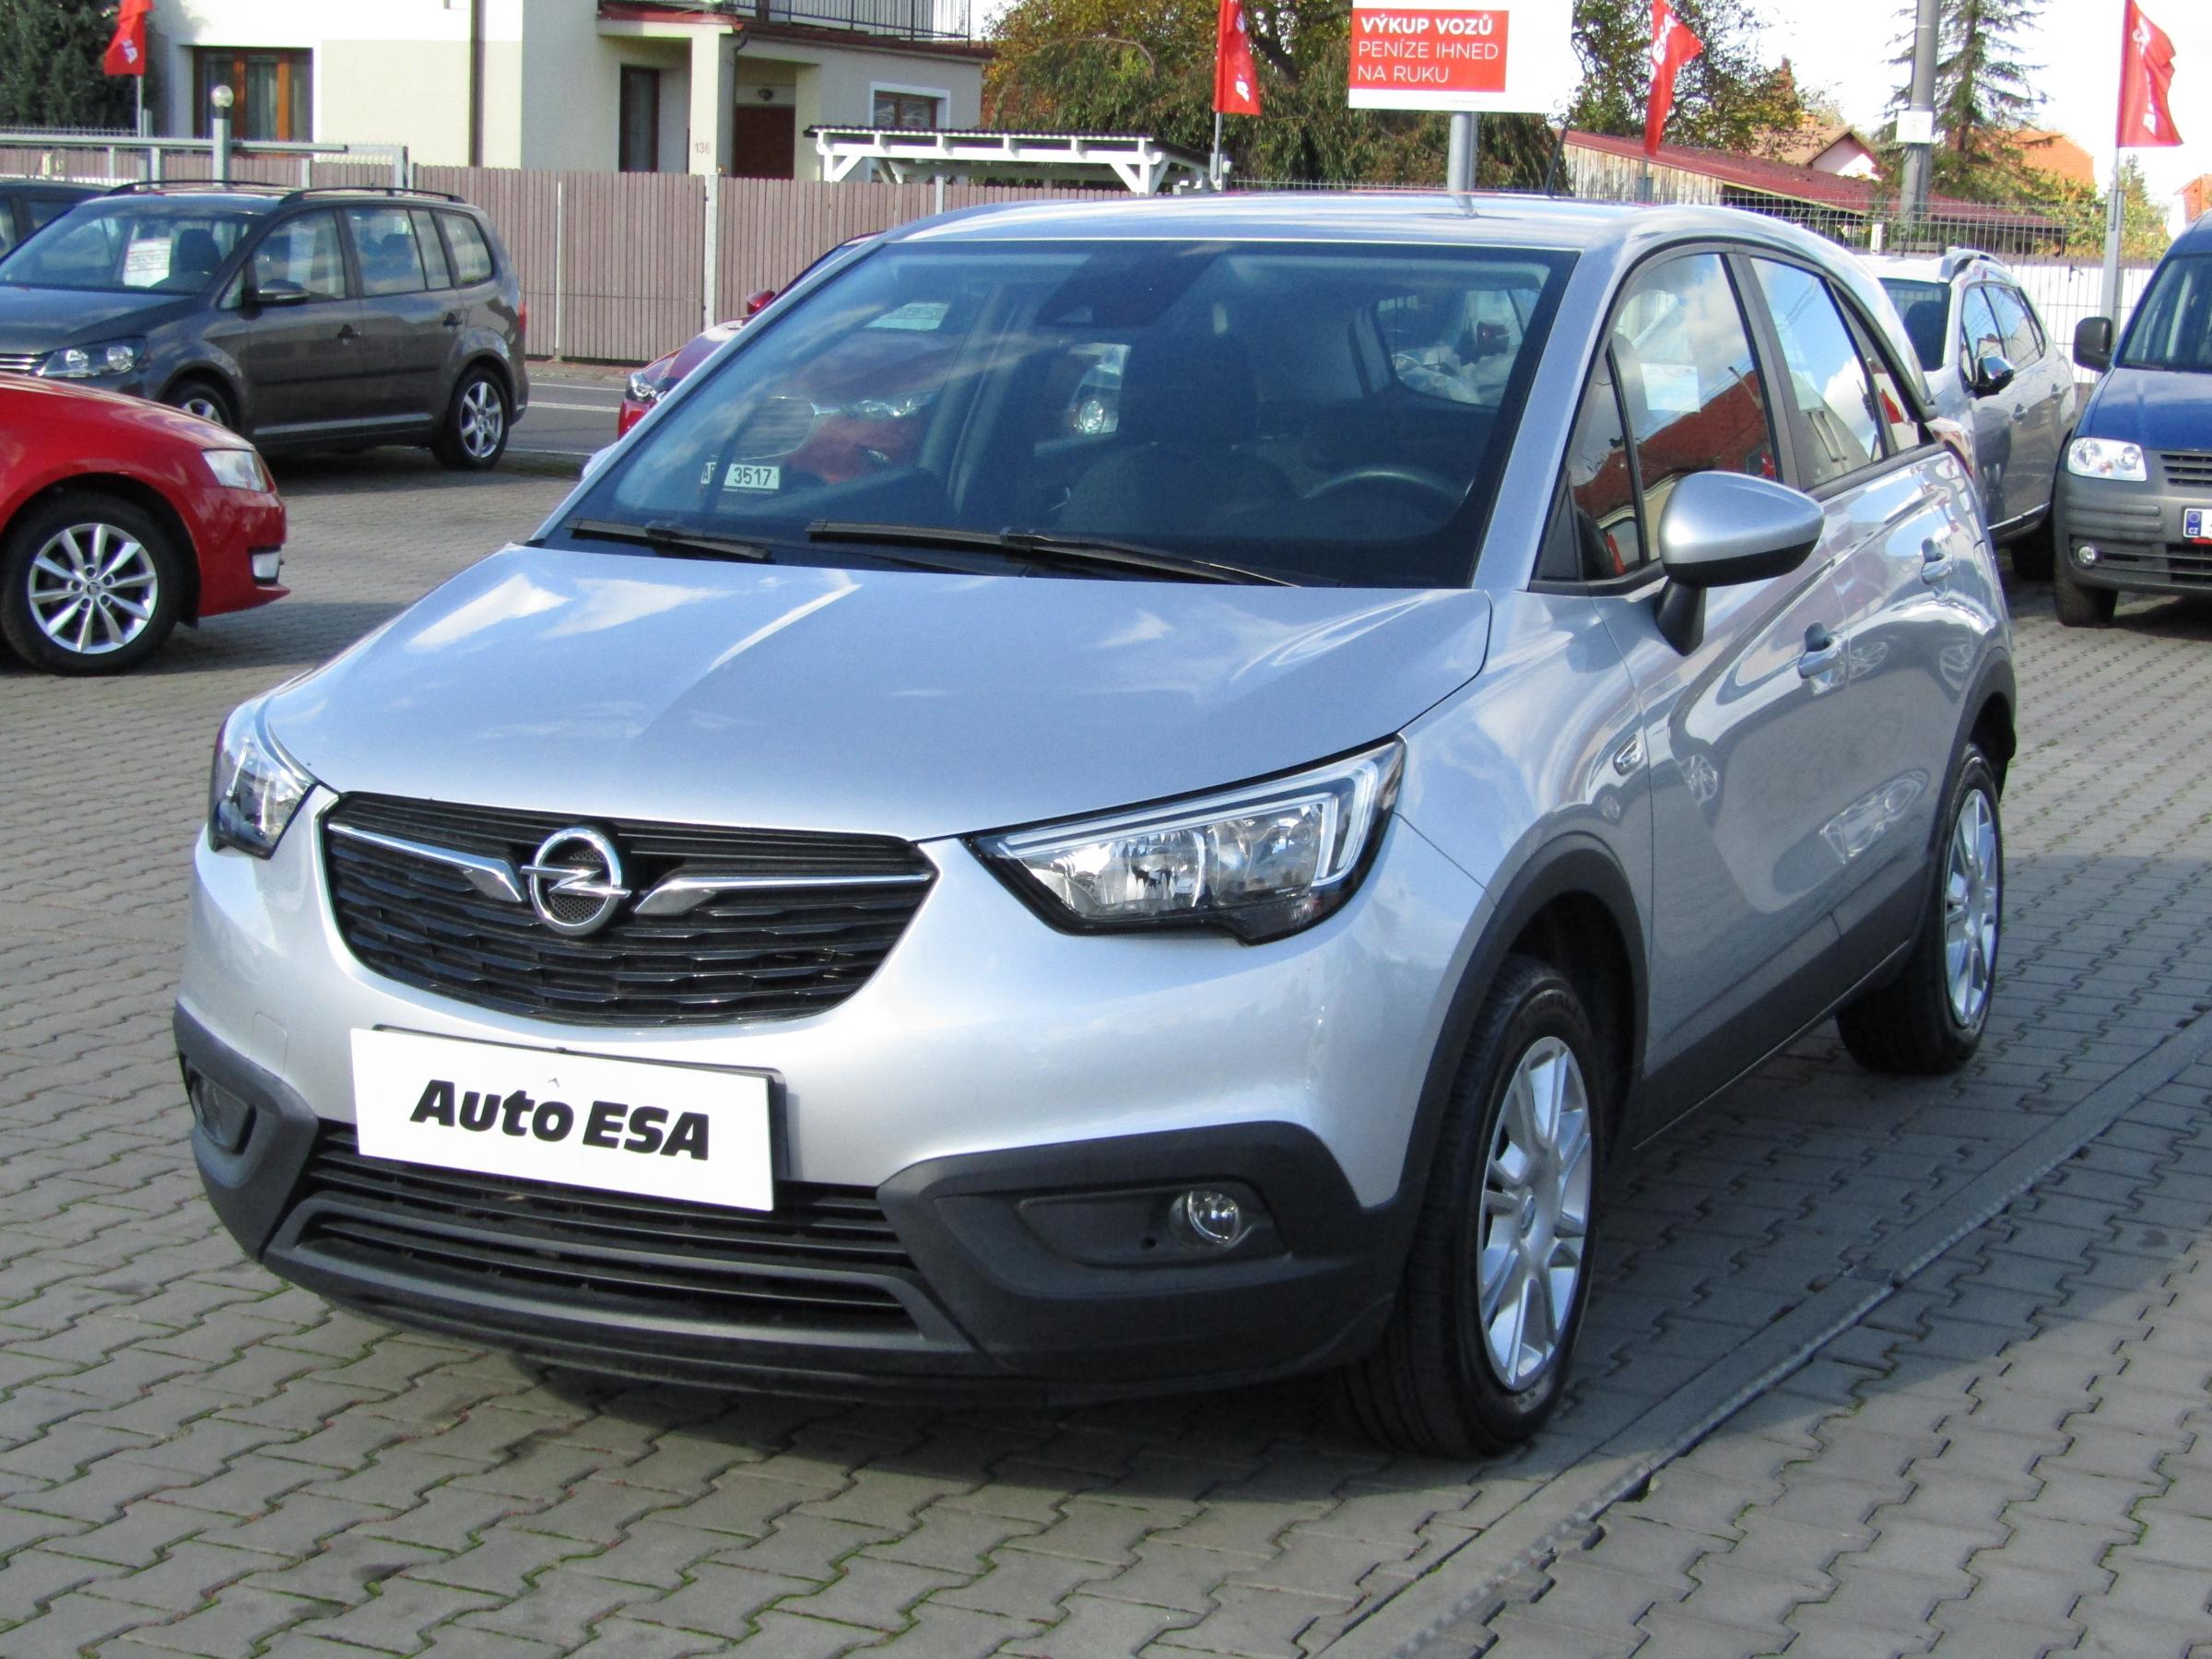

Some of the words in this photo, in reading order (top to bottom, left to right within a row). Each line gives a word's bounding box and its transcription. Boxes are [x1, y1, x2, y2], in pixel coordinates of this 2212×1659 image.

[1361, 14, 1430, 35] VÝKUP
[1435, 14, 1493, 36] VOZŮ
[1358, 39, 1430, 59] PENÍZE
[1436, 42, 1499, 61] IHNED
[1357, 65, 1387, 82] NA
[1393, 66, 1450, 84] RUKU
[693, 141, 712, 155] 136
[734, 466, 772, 487] 3517
[2188, 526, 2199, 535] CZ
[409, 1079, 575, 1143] Auto
[582, 1100, 710, 1161] ESA
